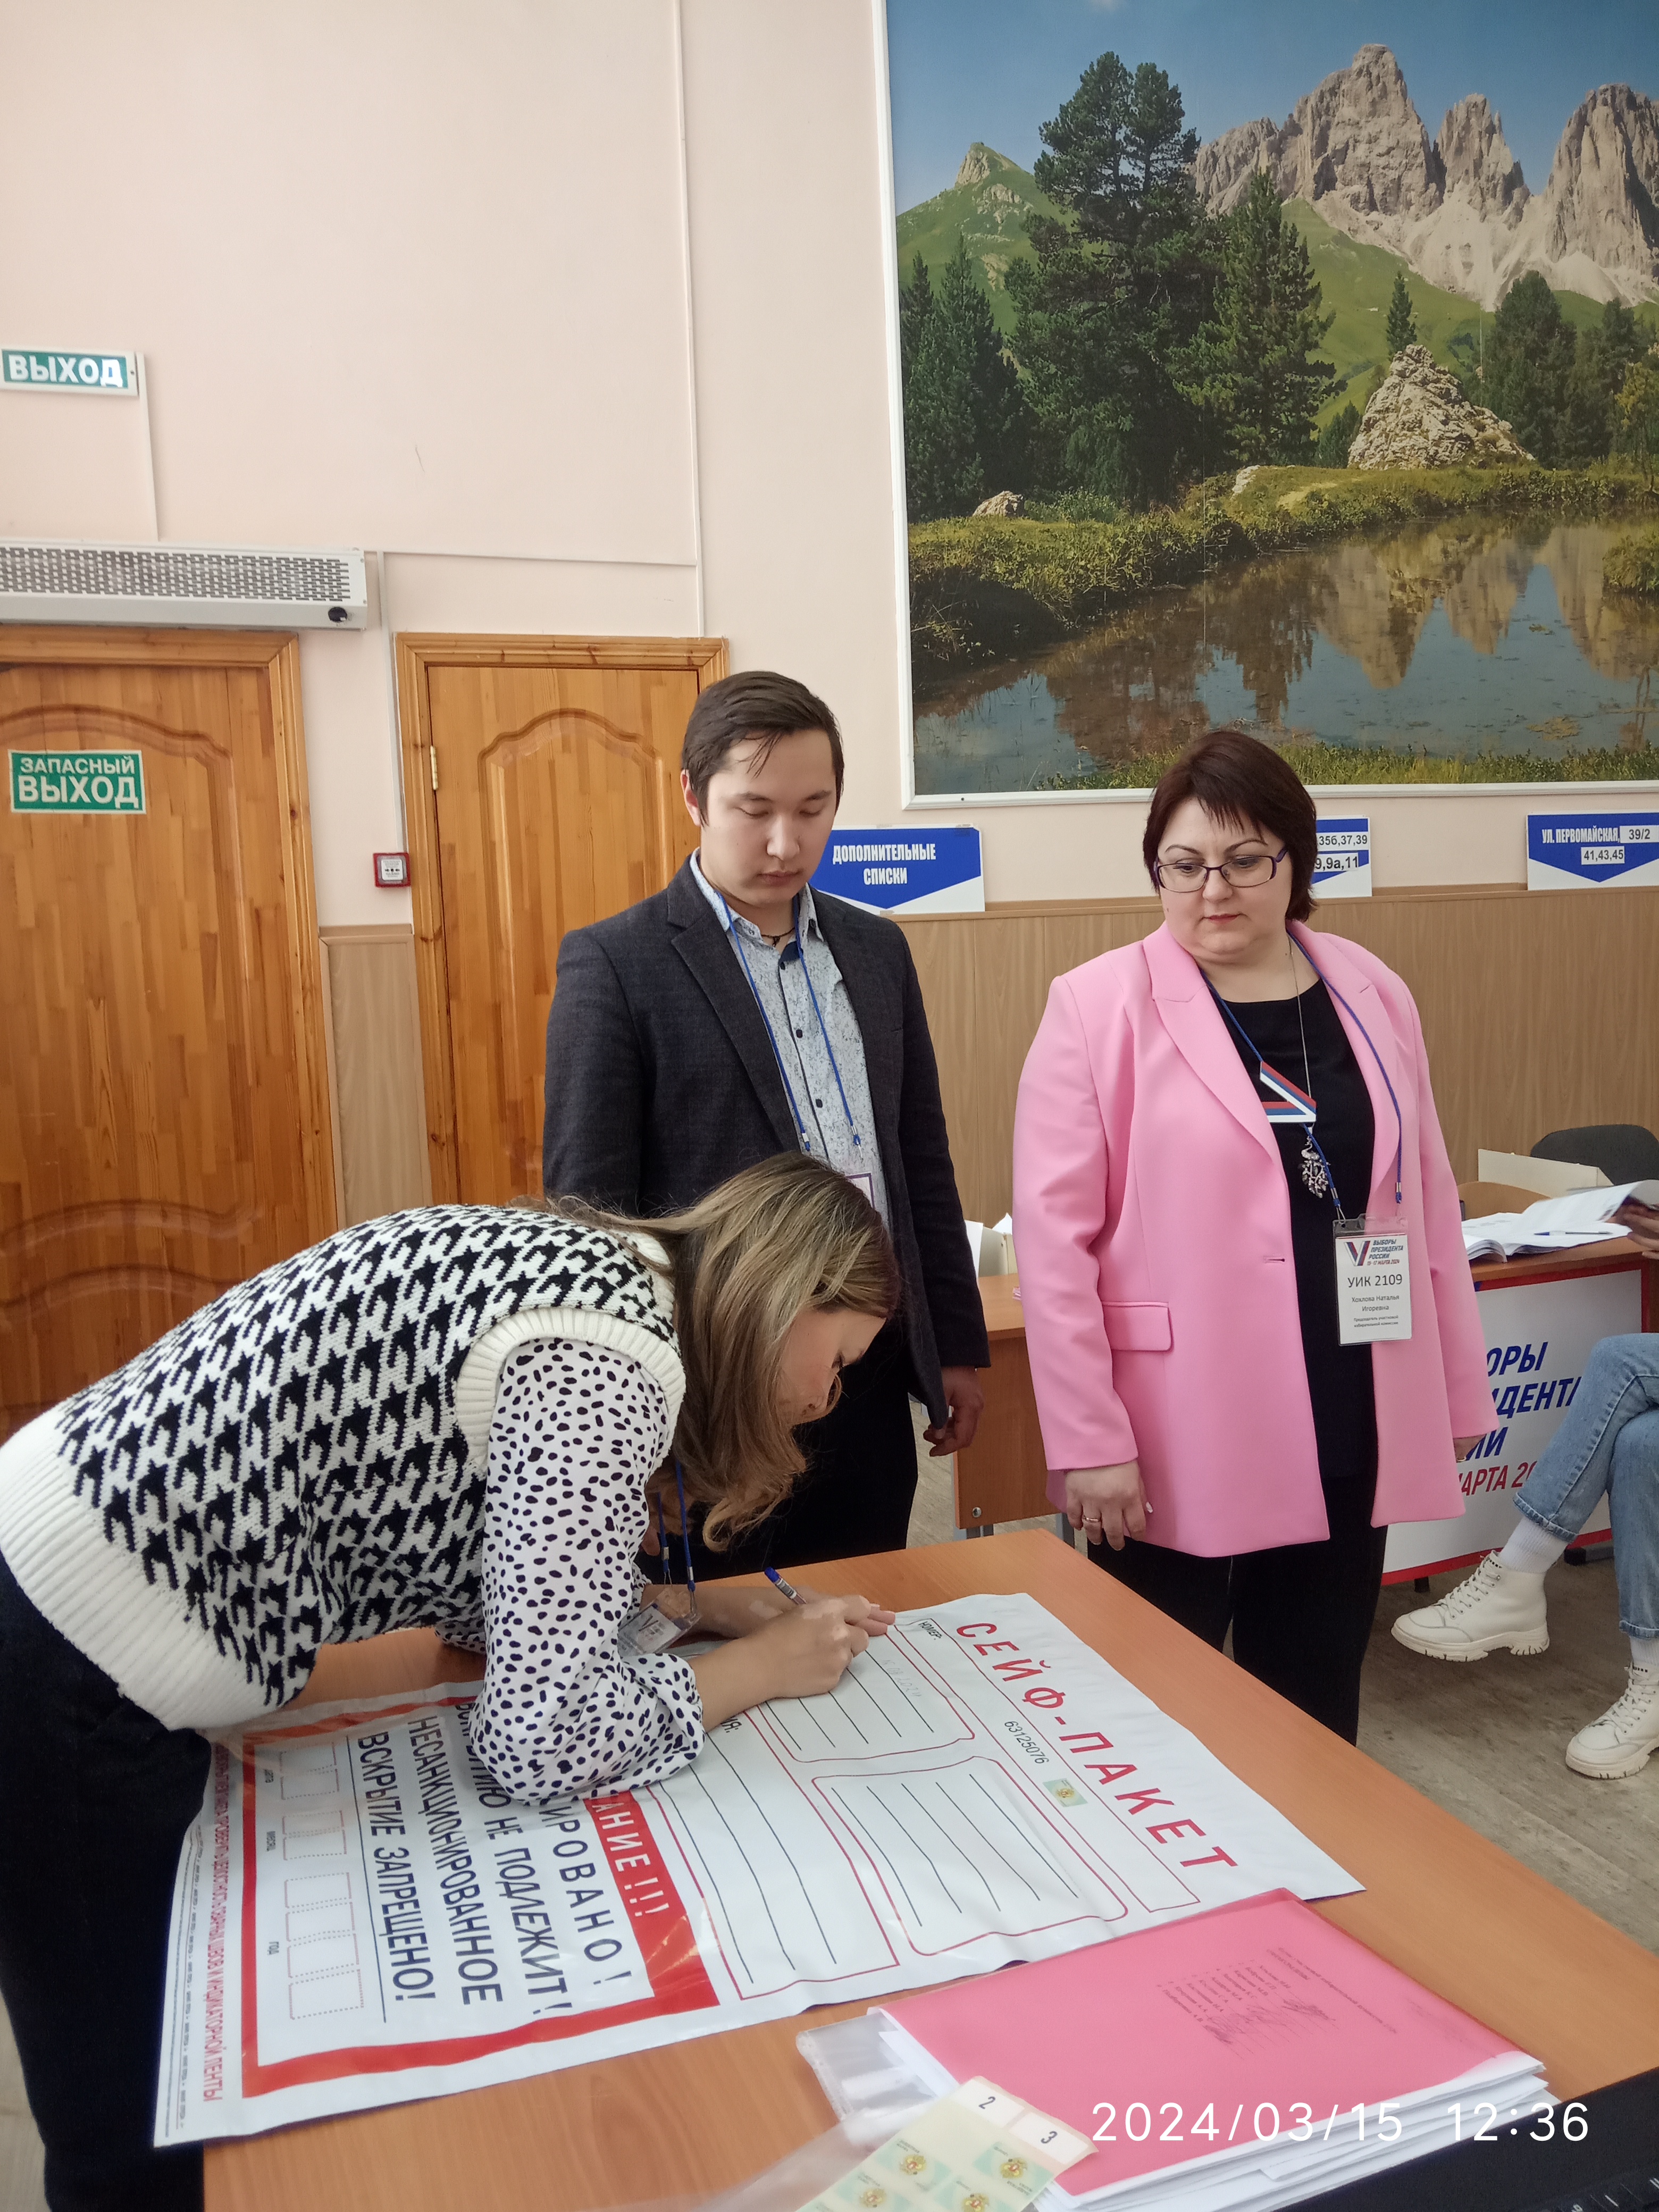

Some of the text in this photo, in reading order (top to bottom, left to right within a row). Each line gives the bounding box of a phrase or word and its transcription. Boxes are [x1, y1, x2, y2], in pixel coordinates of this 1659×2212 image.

[9, 354, 123, 388] ВЫХОД
[20, 755, 135, 774] ЗАПАСНЫЙ
[18, 775, 139, 809] ВЫХОД
[1542, 825, 1650, 843] УЛ. ПЕРВОМАЙСКАЯ, 39/2
[832, 843, 936, 865] ДОПОЛНИТЕЛЬНЫЕ
[1583, 849, 1624, 862] 41,43,45
[864, 867, 908, 885] СПИСКИ
[1347, 1274, 1402, 1287] УИК 2109
[1487, 1342, 1548, 1377] ОРЫ
[918, 1621, 942, 1641] НОМЕР:
[957, 1623, 1238, 1867] СЕЙФ-ПАКЕТ
[1004, 1720, 1049, 1764] 63125076
[484, 1816, 524, 1840] НЕ
[357, 1731, 436, 2001] ВСКРЫТИЕ ЗАПРЕЩЕНО!
[407, 1715, 504, 2005] НЕСАНКЦИОНИРОВАННОЕ
[494, 1847, 573, 2015] ПОДЛЕЖИТ!
[204, 1978, 227, 2054] ИНДИКАТОРНОЙ
[203, 2055, 223, 2101] ЛЕНТЫ
[978, 2096, 996, 2110] 2
[1040, 2130, 1058, 2144] 3
